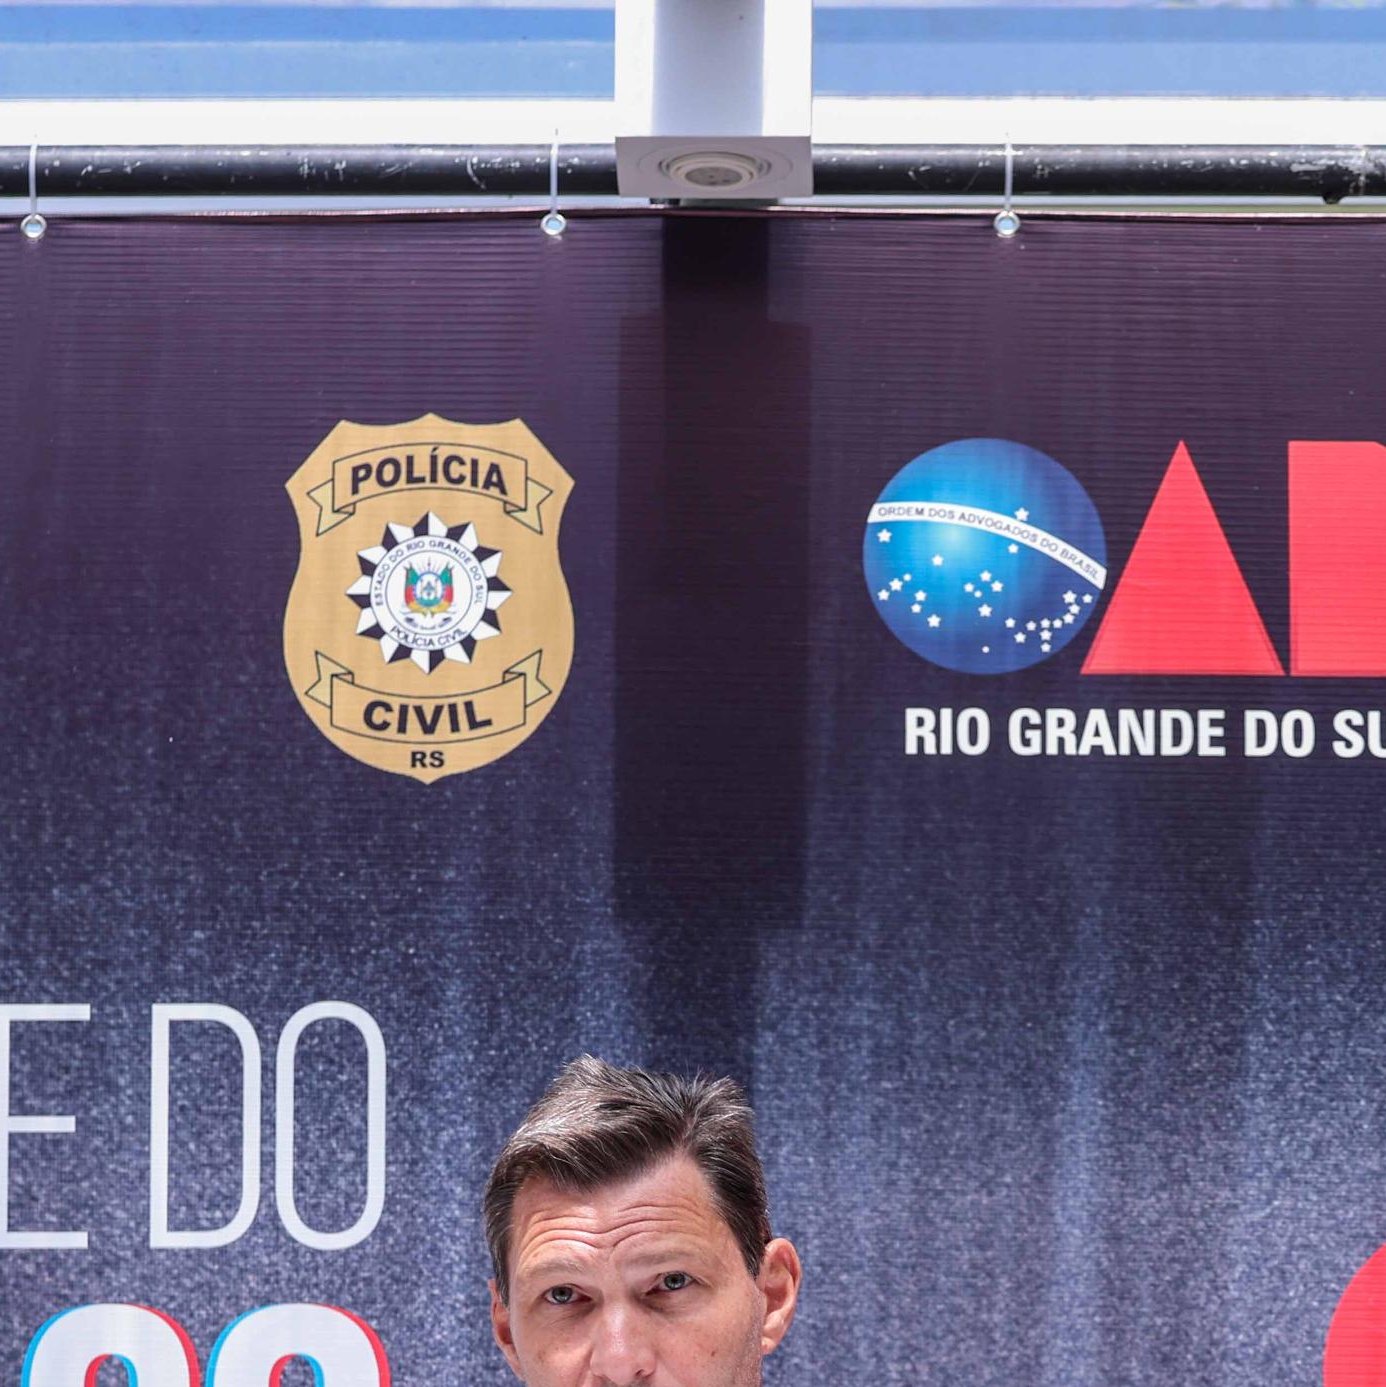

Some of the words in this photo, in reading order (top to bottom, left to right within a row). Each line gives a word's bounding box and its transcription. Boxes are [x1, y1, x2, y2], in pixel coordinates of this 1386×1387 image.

[350, 446, 509, 496] POLÍCIA
[878, 507, 925, 517] ORDEM
[929, 508, 955, 519] DOS
[959, 511, 1039, 545] ADVOGADOS
[1040, 536, 1059, 553] DO
[1059, 548, 1100, 581] BRASIL
[374, 564, 390, 607] ESTADO
[389, 549, 404, 563] DO
[406, 540, 425, 552] RIO
[429, 540, 472, 565] GRANDE
[470, 565, 482, 582] DO
[363, 699, 493, 735] CIVIL
[904, 707, 990, 756] RIO
[1008, 707, 1226, 757] GRANDE
[1244, 710, 1314, 757] DO
[410, 750, 445, 769] RS
[149, 1002, 387, 1250] DO
